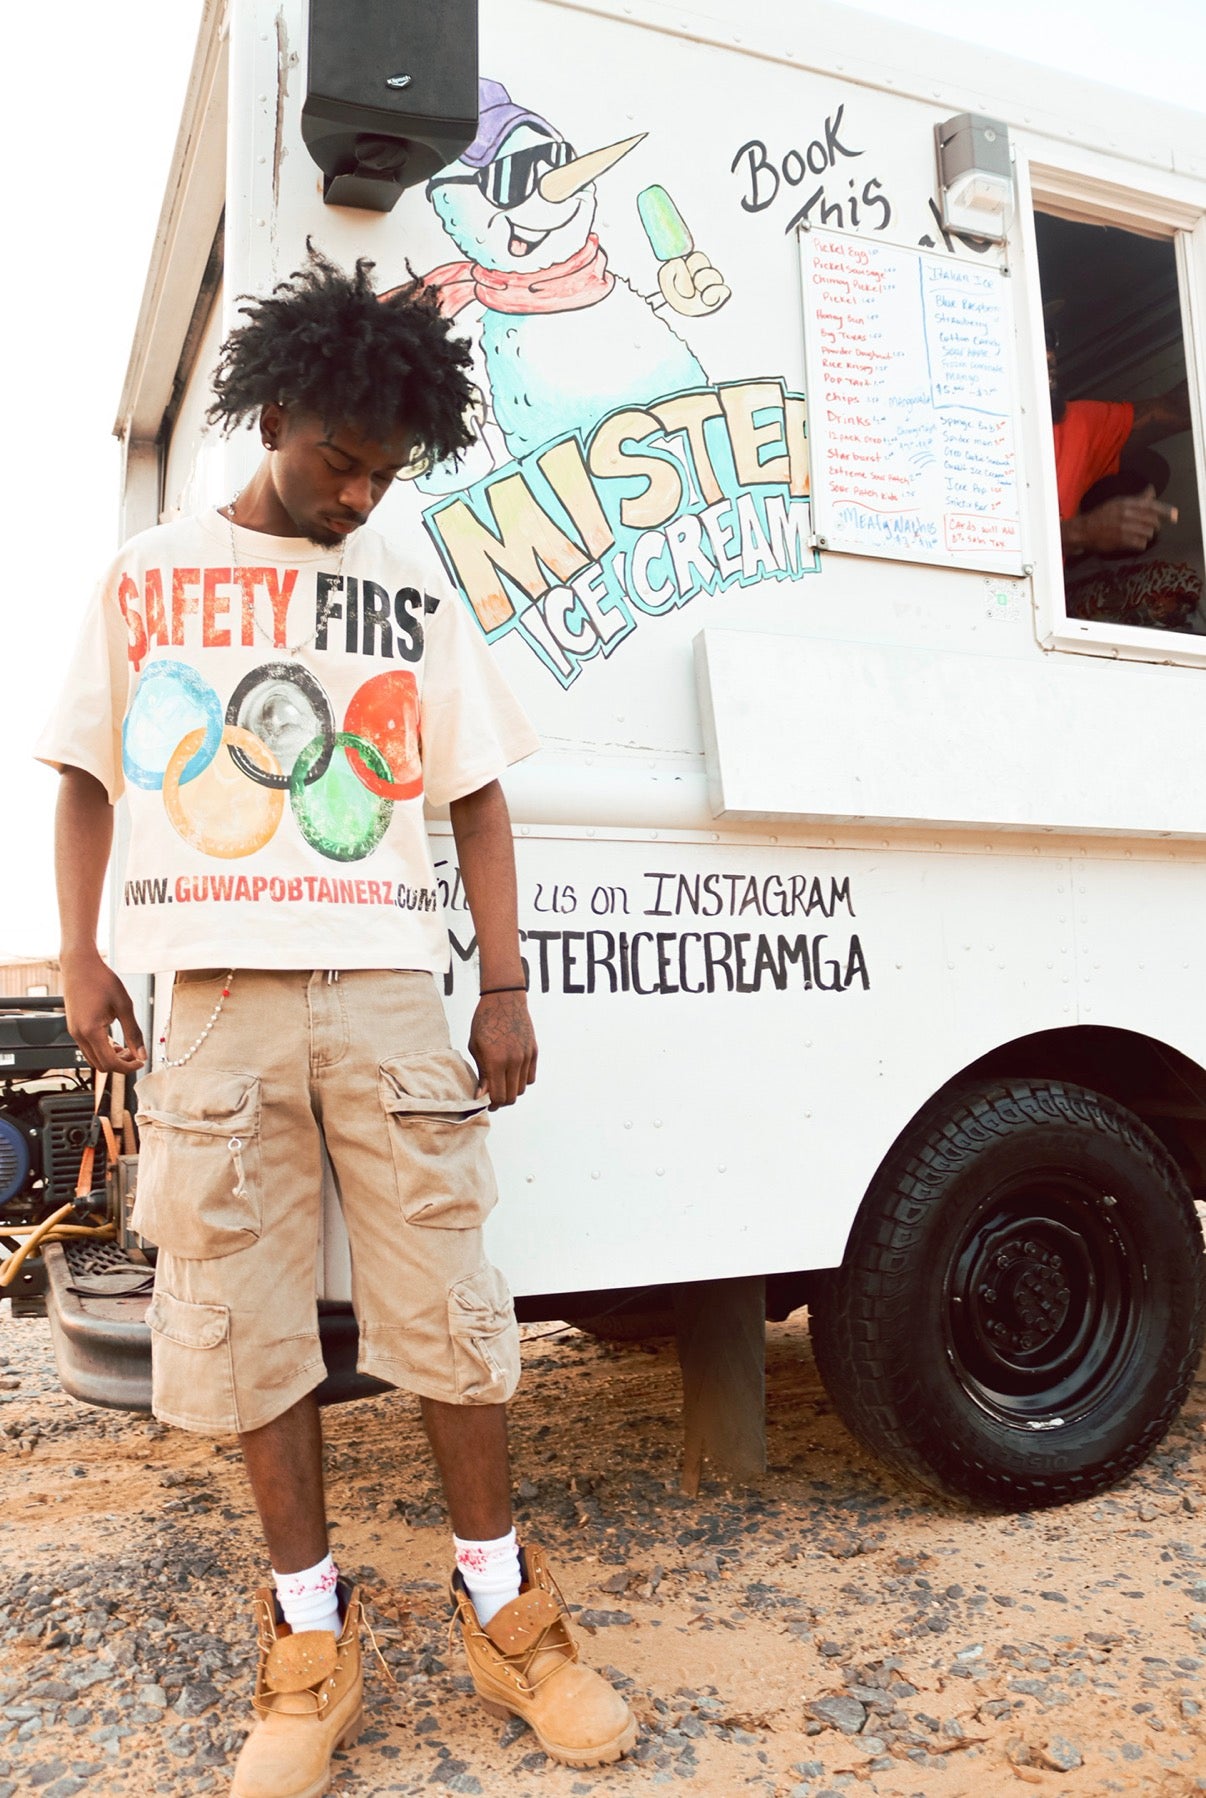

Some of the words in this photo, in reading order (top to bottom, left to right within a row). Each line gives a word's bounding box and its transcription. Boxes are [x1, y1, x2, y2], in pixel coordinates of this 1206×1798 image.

[731, 103, 865, 213] Book
[632, 493, 817, 607] CREAM
[125, 874, 436, 912] WW.GUWAPOBTAINERZ.COM
[534, 884, 577, 915] us
[590, 886, 630, 914] on
[643, 872, 856, 918] INSTAGRAM
[444, 928, 871, 996] MTERICECREAMGA
